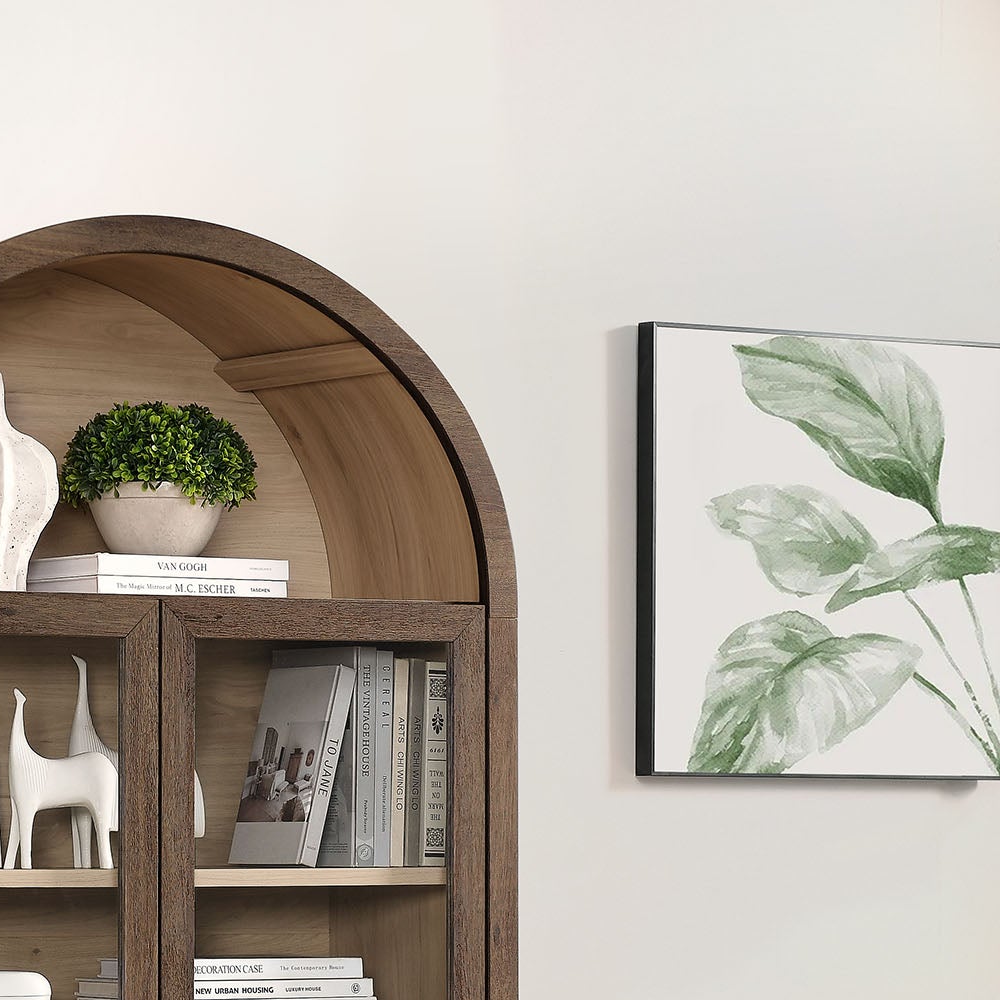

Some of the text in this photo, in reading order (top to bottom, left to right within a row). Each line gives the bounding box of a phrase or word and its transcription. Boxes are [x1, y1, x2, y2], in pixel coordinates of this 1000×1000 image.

[157, 561, 207, 572] VAN GOGH
[128, 583, 145, 591] Magic
[175, 583, 196, 593] M.C.
[198, 584, 235, 594] ESCHER
[362, 664, 371, 687] THE
[382, 665, 390, 728] CEREAL
[397, 716, 405, 744] ARTS
[413, 716, 421, 744] ARTS
[327, 738, 340, 756] TO
[317, 760, 335, 797] JANE
[429, 769, 444, 777] WALL
[431, 780, 442, 788] THE
[430, 813, 441, 821] THE
[243, 964, 264, 974] CASE
[195, 986, 274, 995] NEW URBAN HOUSING
